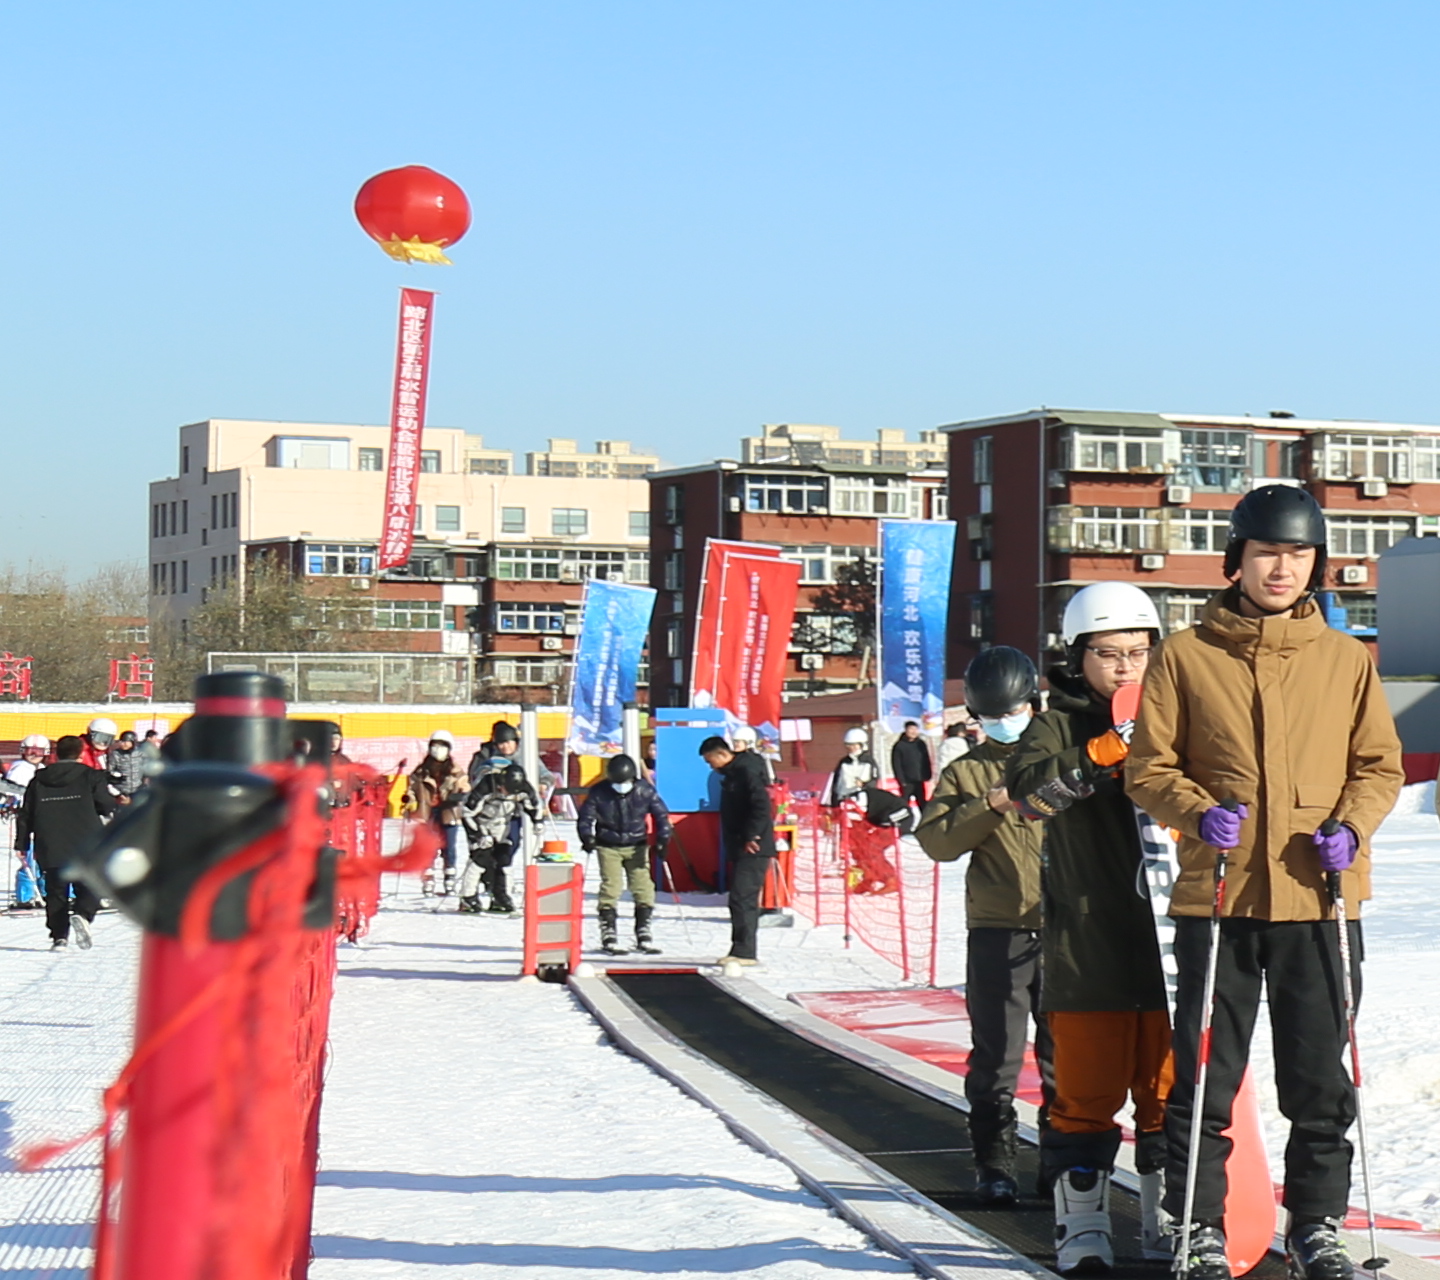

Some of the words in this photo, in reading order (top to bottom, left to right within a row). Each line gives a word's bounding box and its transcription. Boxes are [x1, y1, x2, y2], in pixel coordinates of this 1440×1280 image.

[903, 548, 925, 622] 健康河北
[904, 630, 924, 703] 欢乐冰雪
